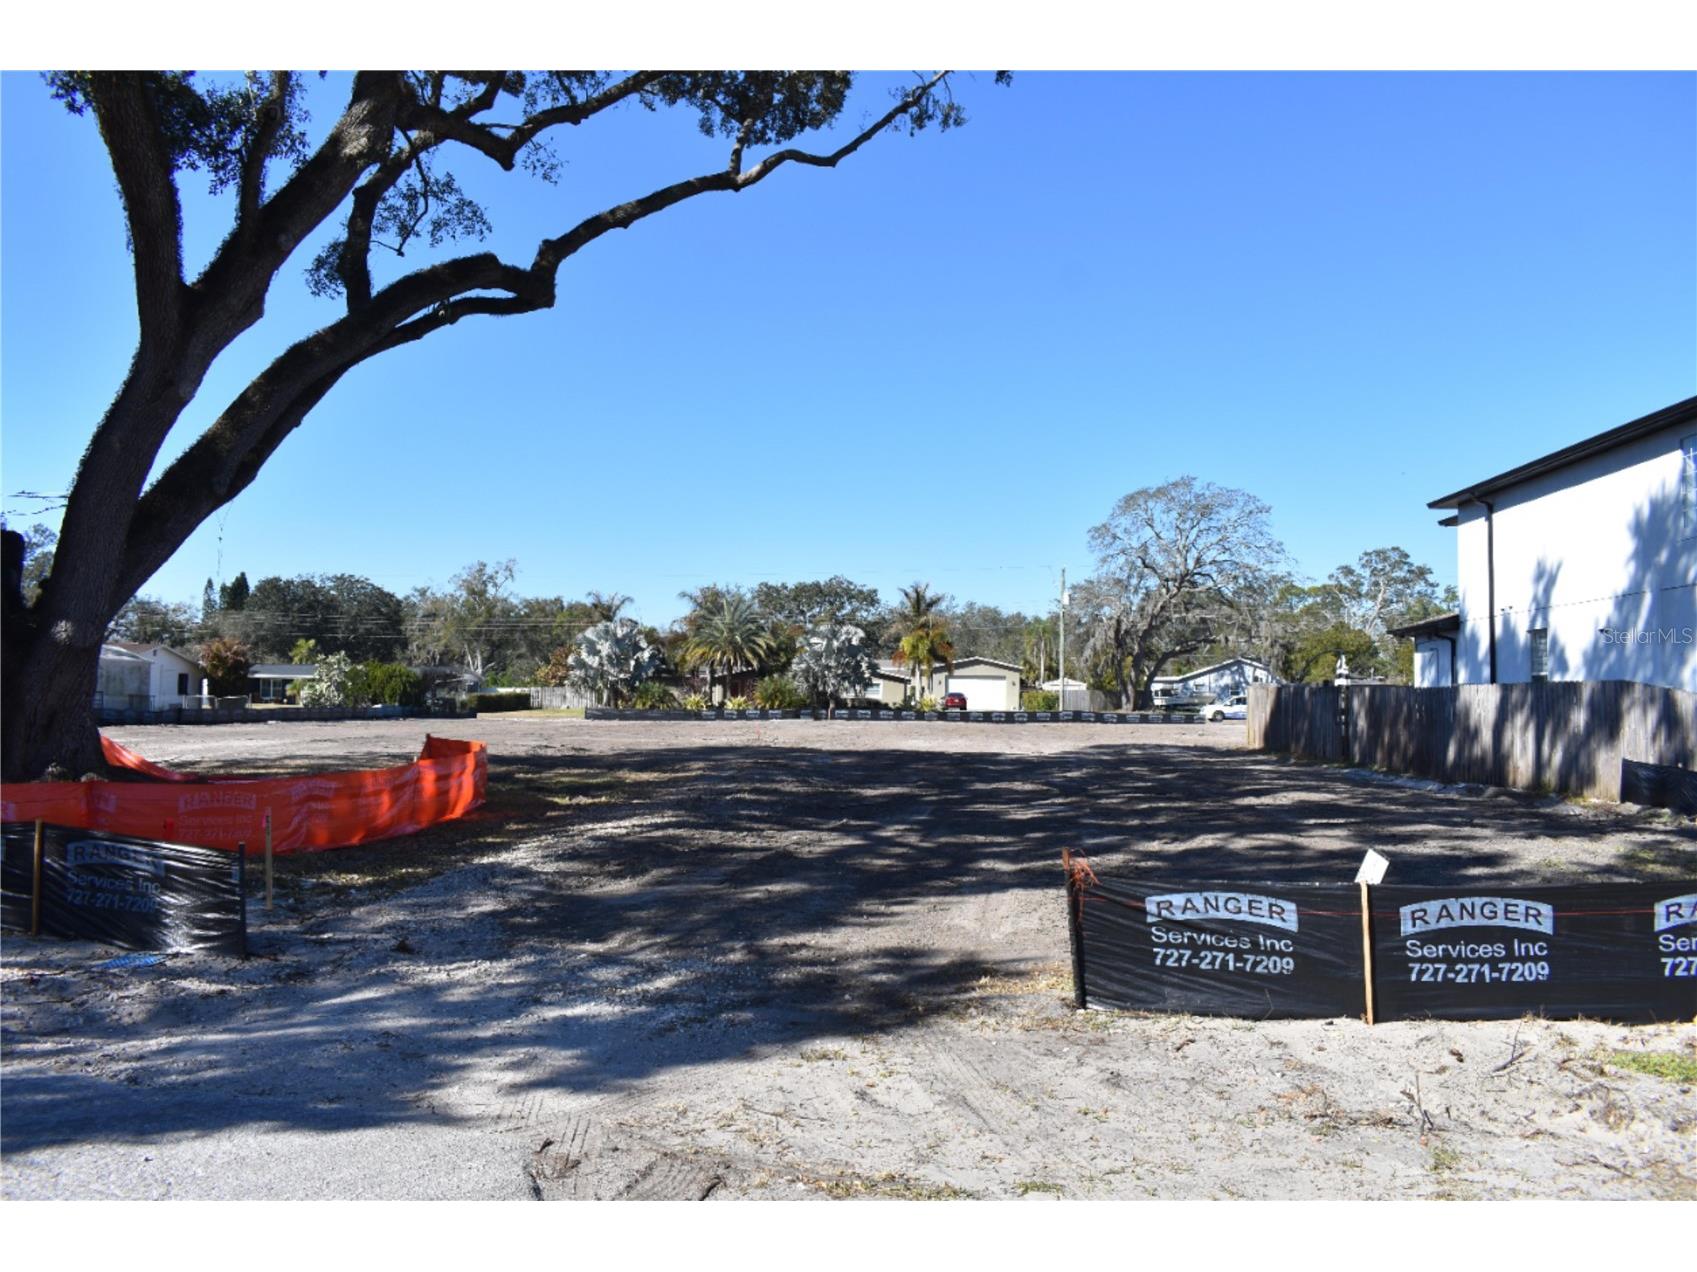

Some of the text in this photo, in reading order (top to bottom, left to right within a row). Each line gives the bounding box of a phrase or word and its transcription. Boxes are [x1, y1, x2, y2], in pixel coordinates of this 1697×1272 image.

[138, 877, 161, 894] Inc
[1155, 895, 1288, 923] RANGER
[1410, 901, 1544, 929] RANGER
[1150, 926, 1294, 952] Services Inc
[1405, 938, 1548, 958] Services Inc
[1152, 947, 1295, 975] 727-271-7209
[1408, 961, 1550, 983] 727-271-7209
